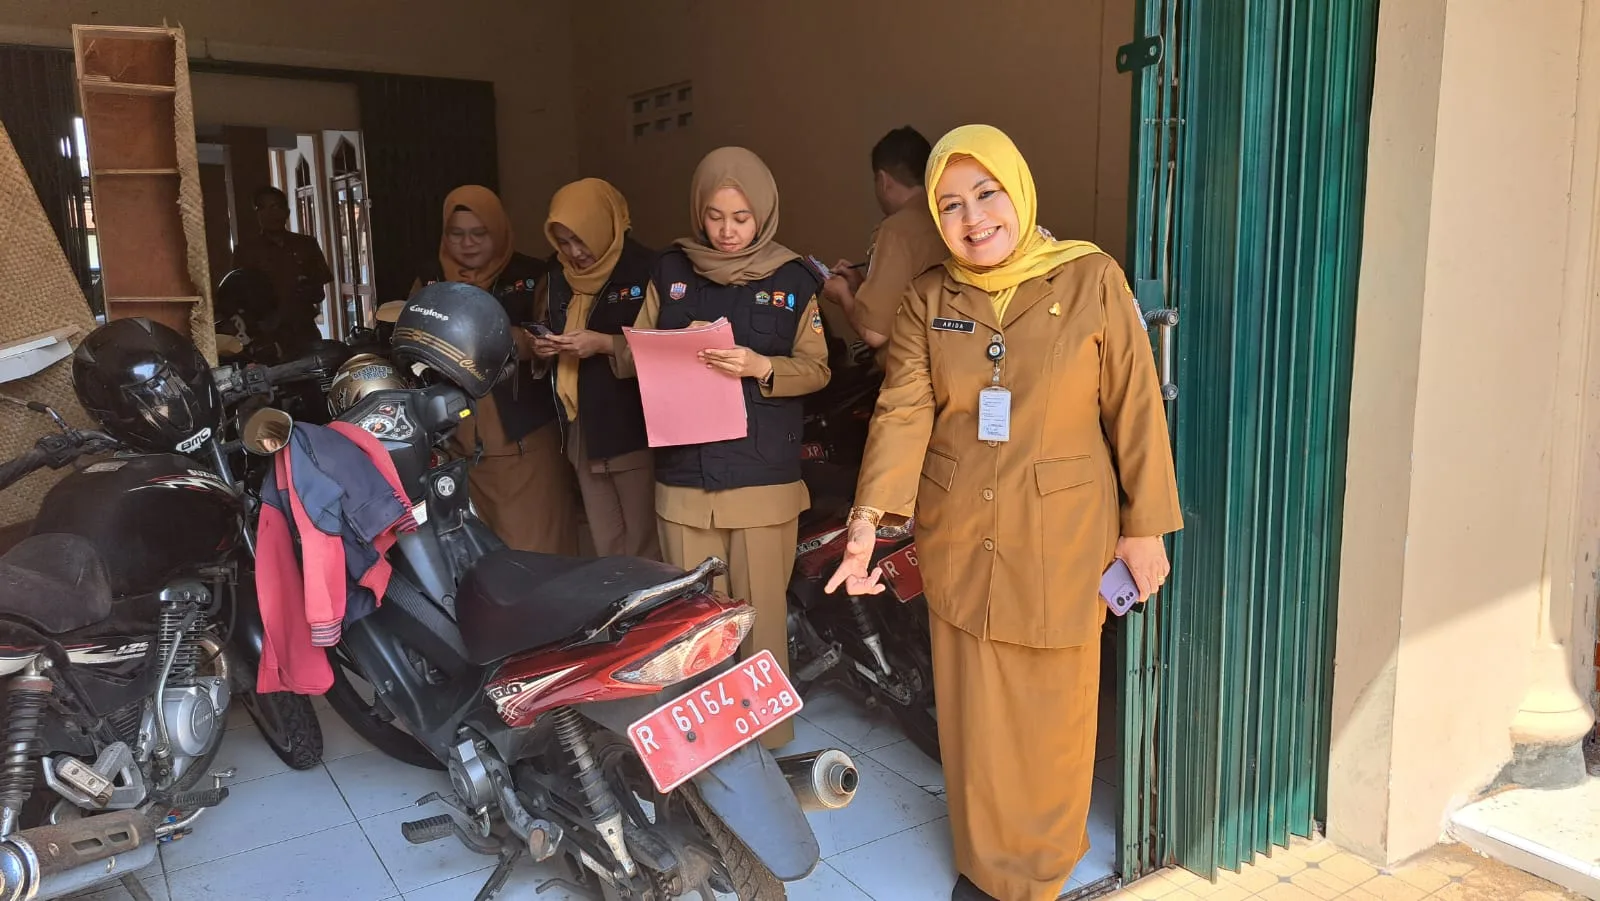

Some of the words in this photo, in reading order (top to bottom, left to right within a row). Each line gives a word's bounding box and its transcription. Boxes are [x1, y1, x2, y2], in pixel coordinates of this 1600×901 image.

[181, 429, 209, 450] BMC
[883, 561, 899, 578] R
[636, 725, 660, 755] R
[671, 682, 735, 731] 6164
[743, 659, 773, 691] XP
